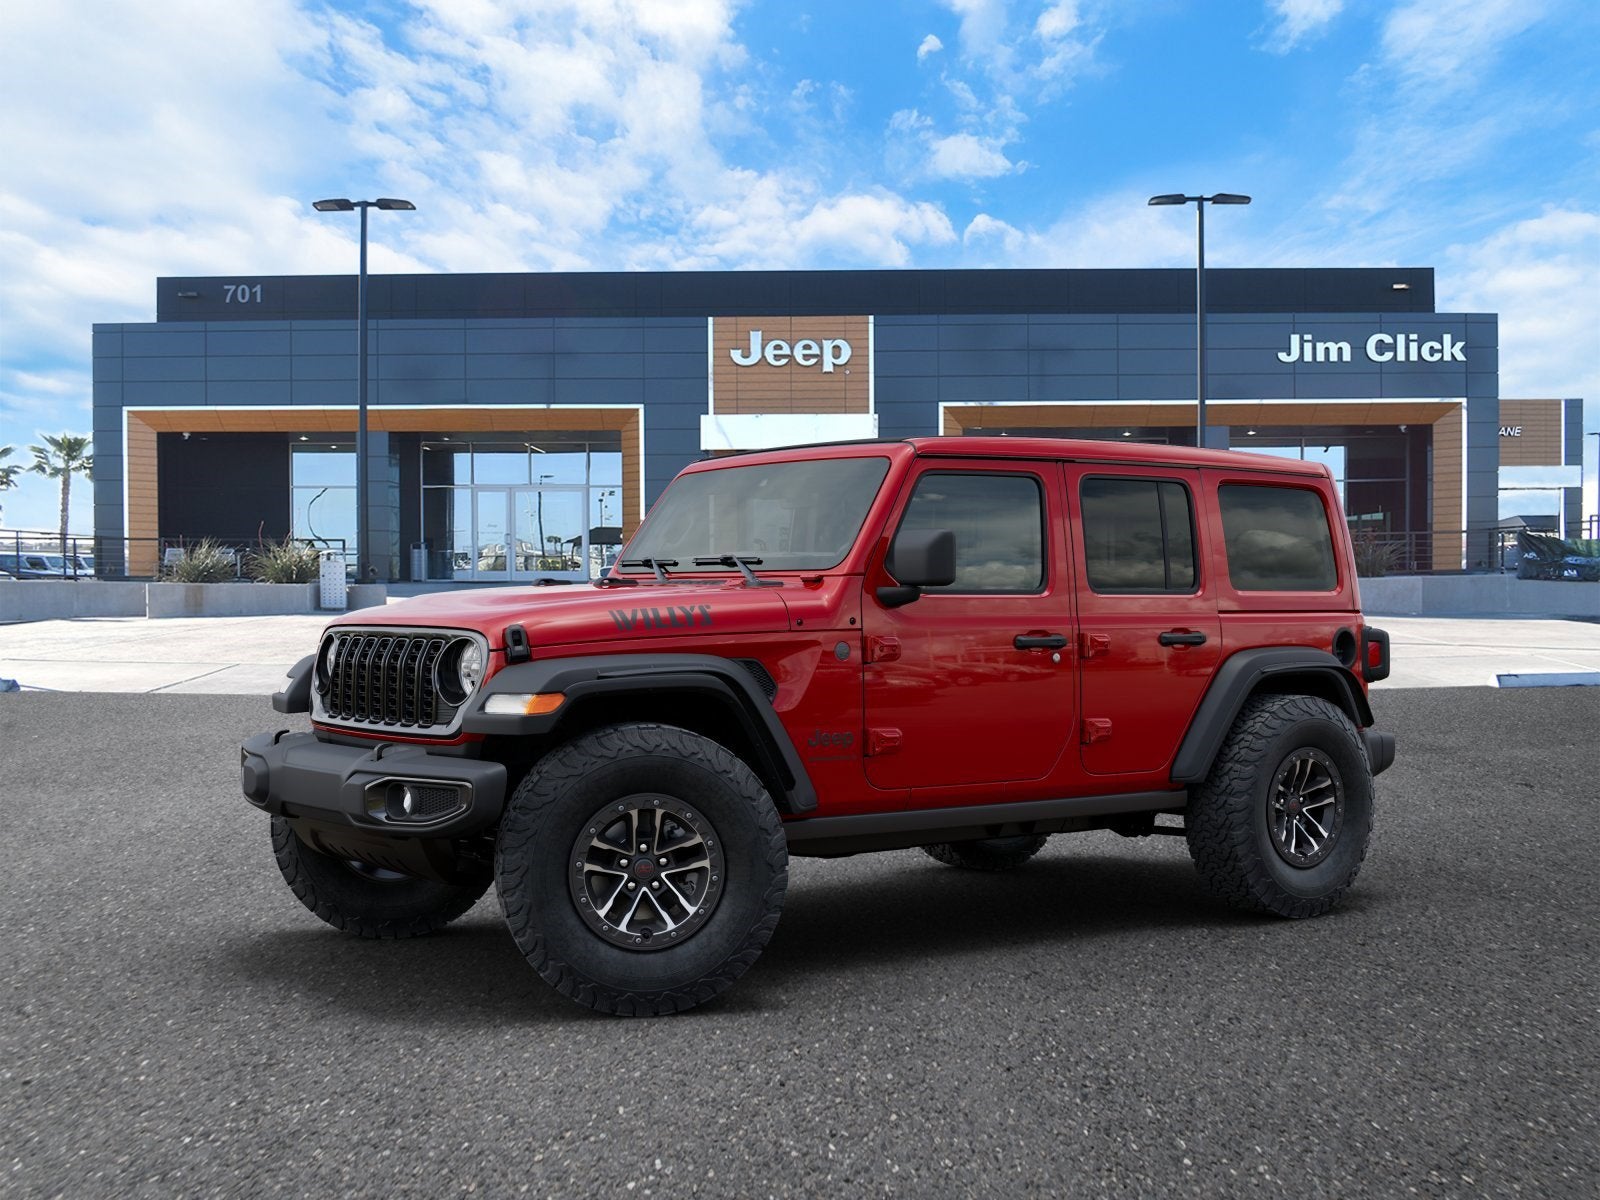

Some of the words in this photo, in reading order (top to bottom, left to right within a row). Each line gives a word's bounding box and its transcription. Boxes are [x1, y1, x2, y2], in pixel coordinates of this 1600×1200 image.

[223, 284, 262, 304] 701
[729, 330, 852, 373] Jeep
[1277, 333, 1351, 363] Jim
[1365, 333, 1467, 363] Click
[608, 604, 712, 631] WILLYS
[807, 729, 855, 749] Jeep
